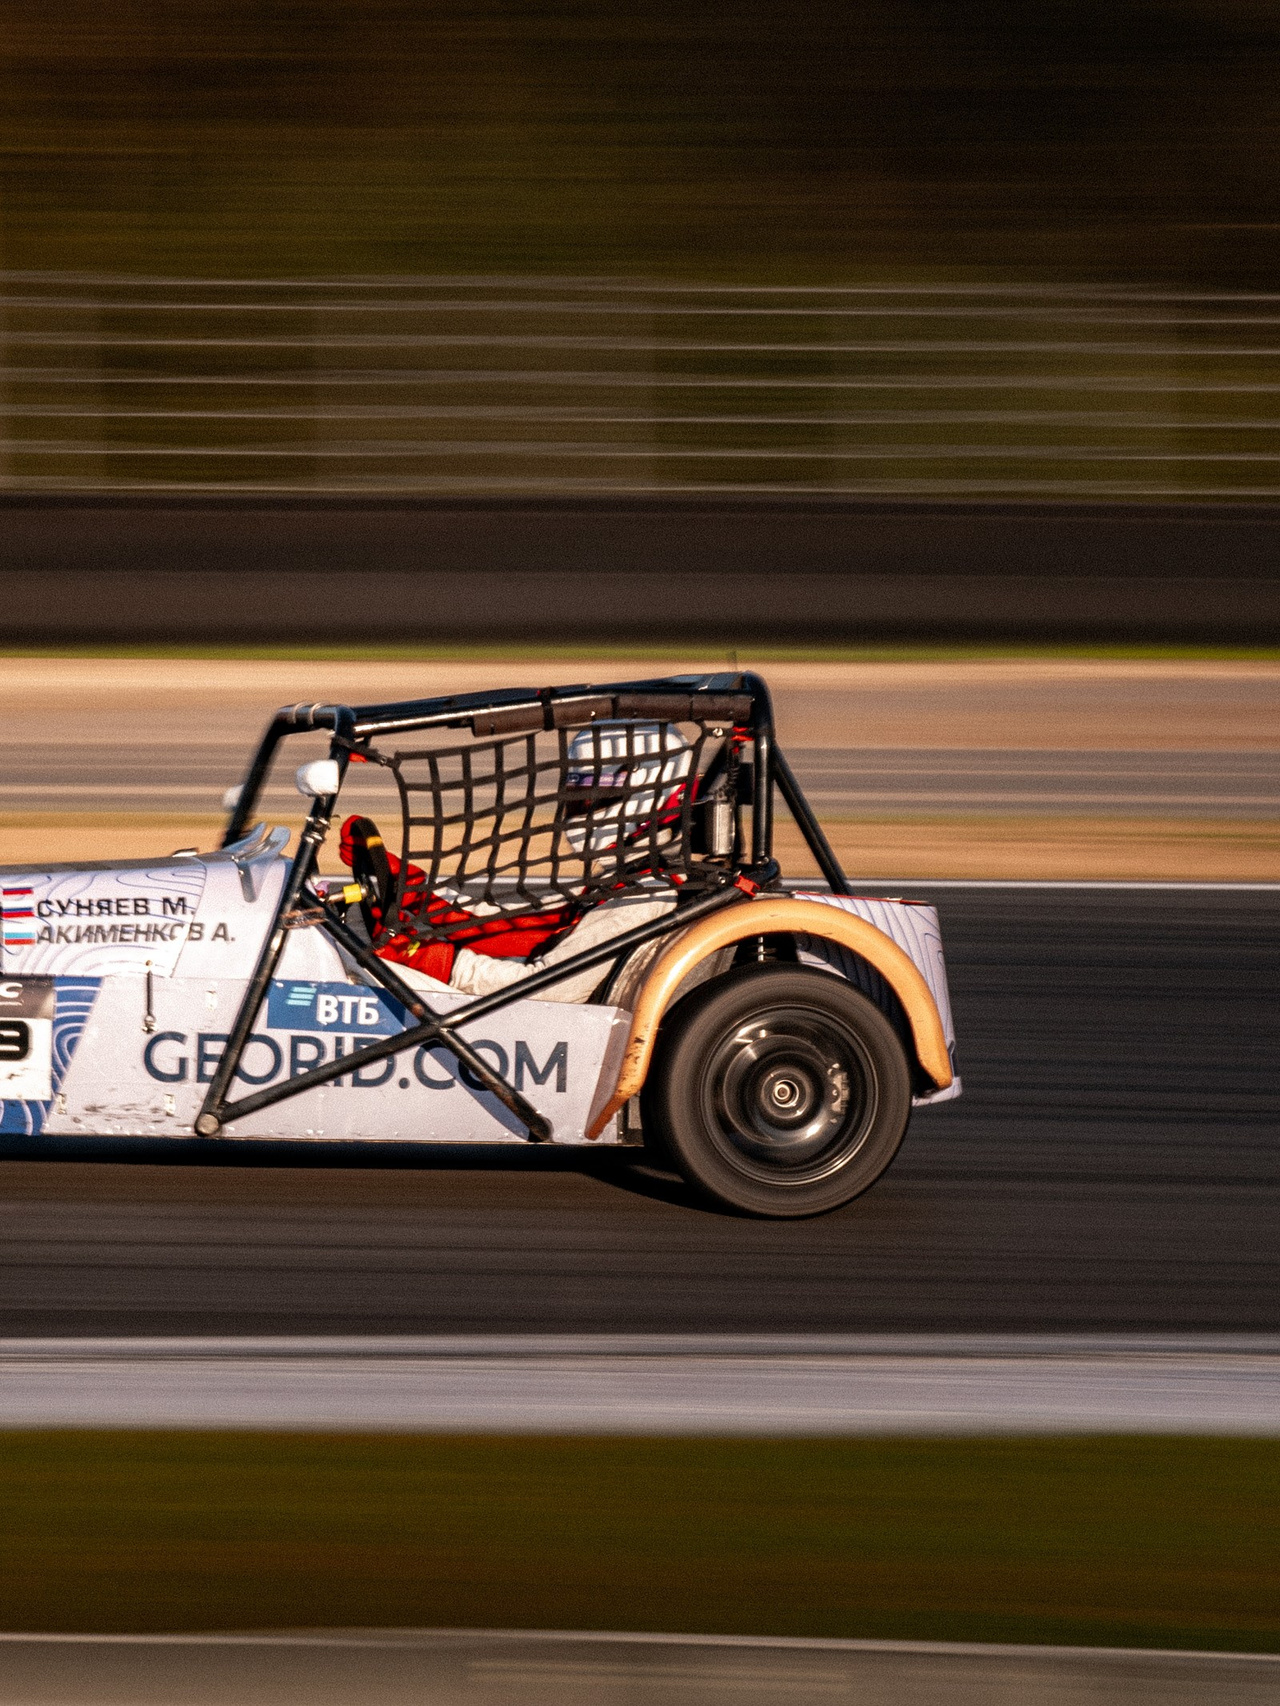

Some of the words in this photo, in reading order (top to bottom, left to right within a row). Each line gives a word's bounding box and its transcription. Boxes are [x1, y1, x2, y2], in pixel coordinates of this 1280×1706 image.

[36, 898, 150, 918] СУНЯЕВ
[162, 896, 195, 916] М.
[211, 922, 236, 943] А.
[316, 994, 380, 1026] ВТБ
[144, 1031, 568, 1093] GEORID.COM
